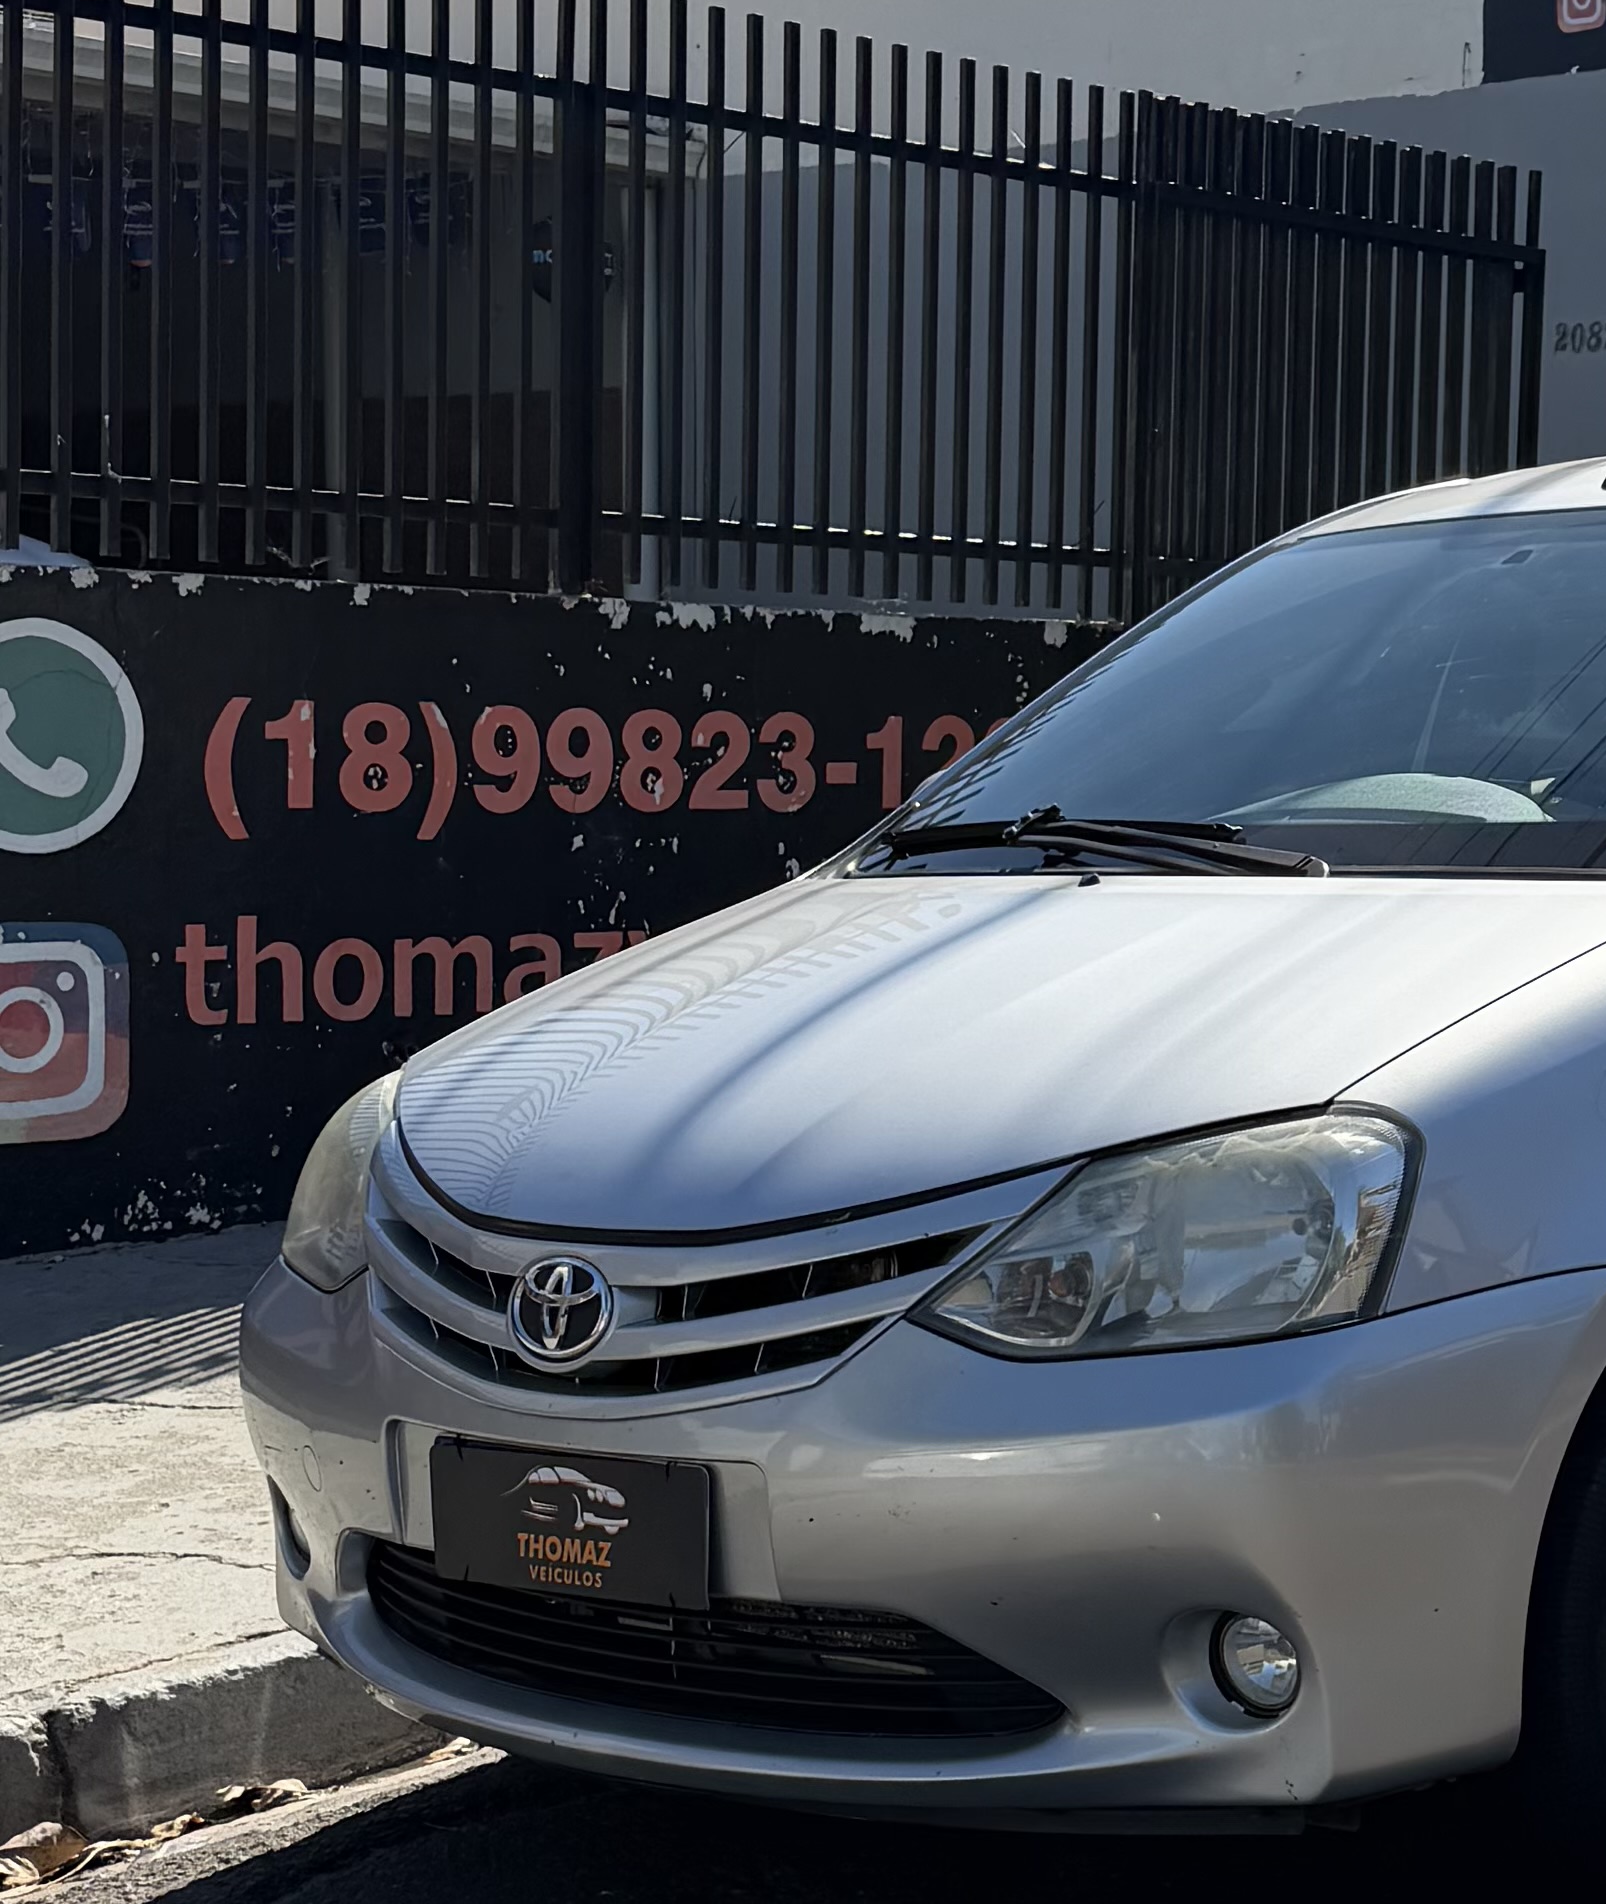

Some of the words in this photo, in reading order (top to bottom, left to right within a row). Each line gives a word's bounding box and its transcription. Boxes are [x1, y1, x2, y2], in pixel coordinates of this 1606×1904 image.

[203, 696, 1009, 841] (18)99823-12
[517, 1532, 612, 1568] THOMAZ
[529, 1562, 603, 1588] VEÍCULOS
